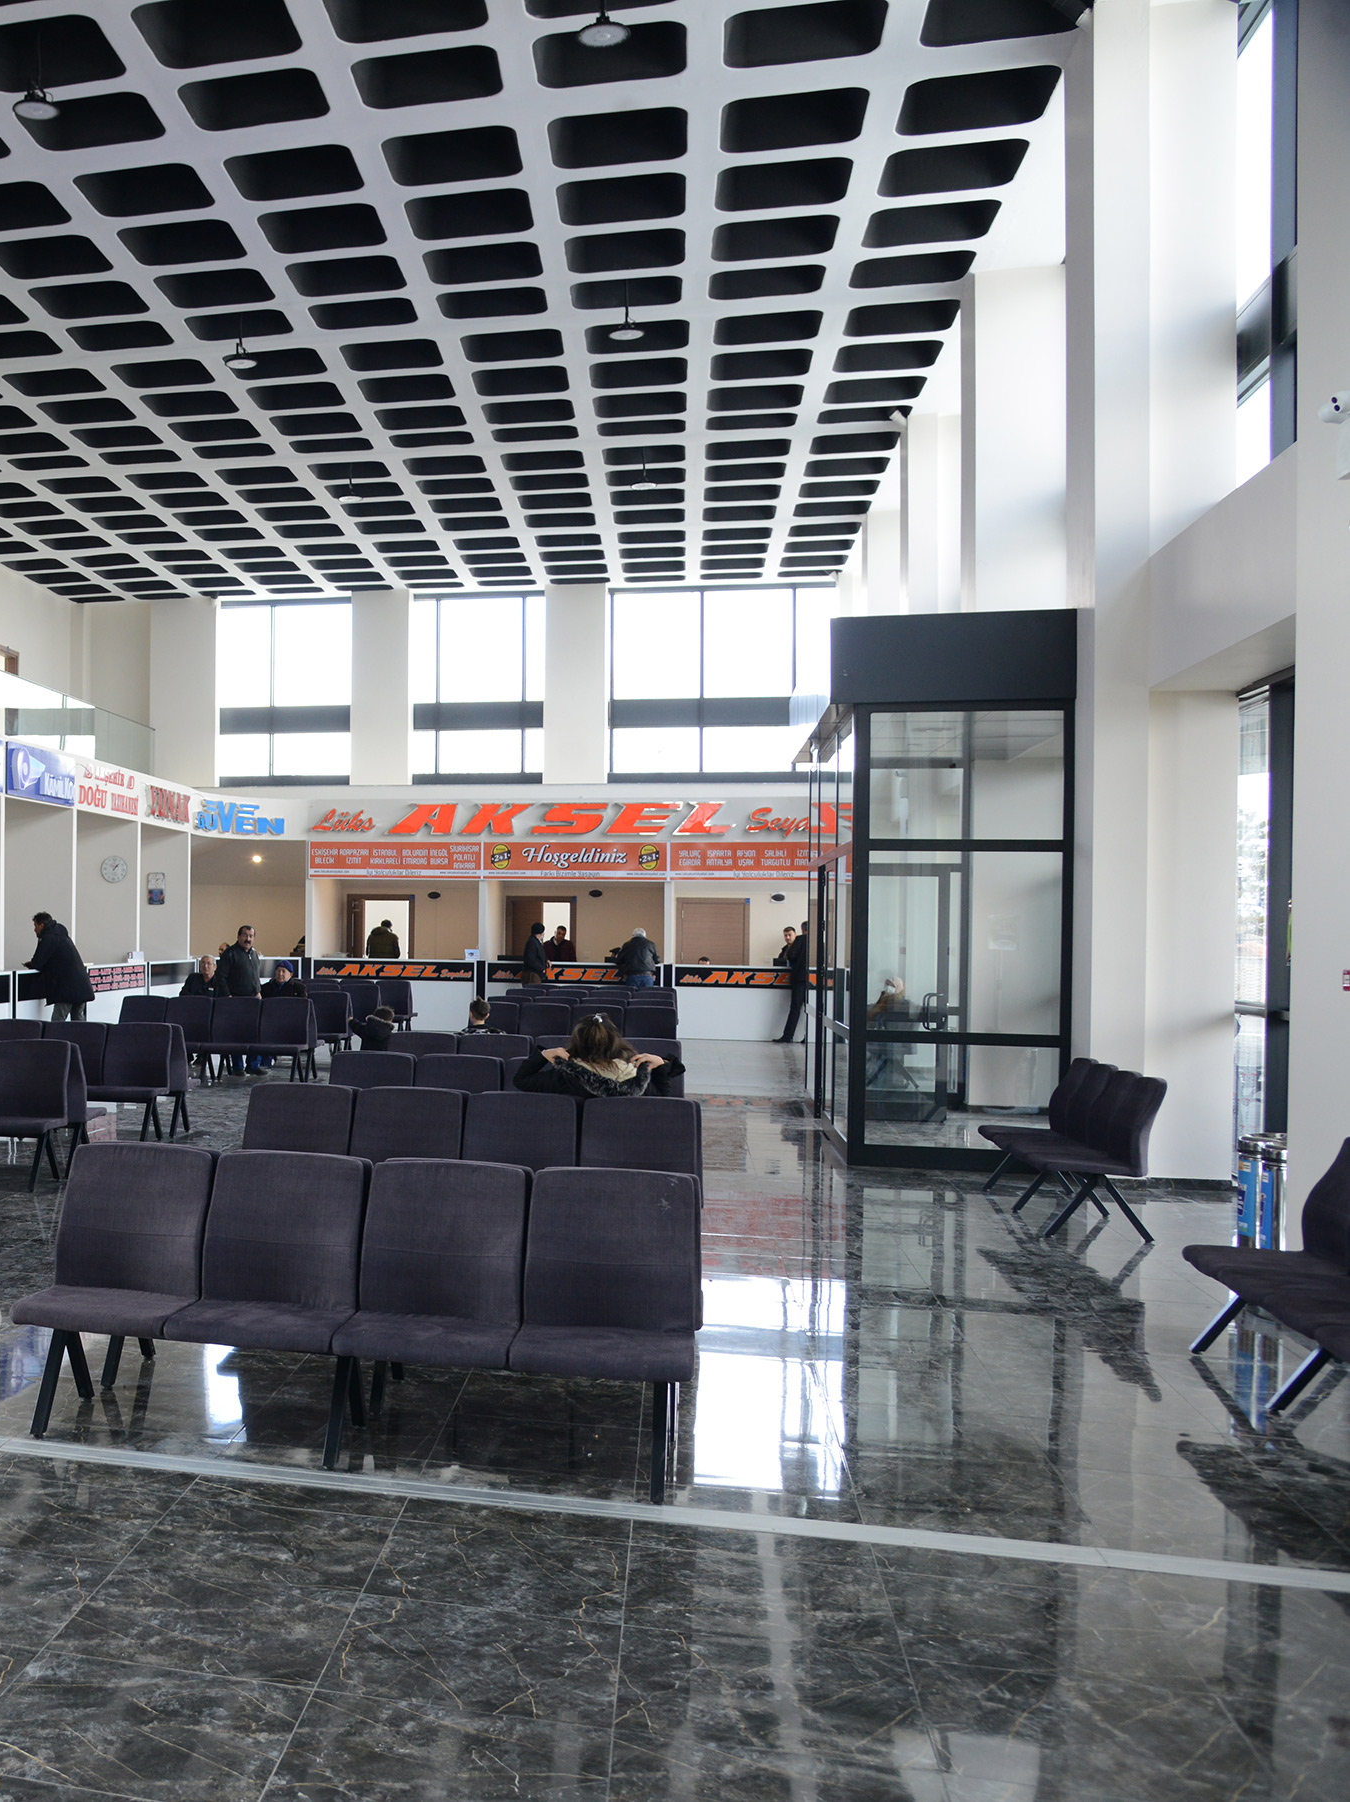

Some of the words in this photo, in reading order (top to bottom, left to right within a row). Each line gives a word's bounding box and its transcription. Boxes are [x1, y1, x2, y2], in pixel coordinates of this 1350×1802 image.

[78, 784, 108, 809] DOĞU
[312, 807, 376, 834] Lüks
[385, 800, 735, 837] AKSEL
[522, 844, 628, 869] Hoşgeldiniz
[338, 963, 440, 978] AKSEL
[703, 970, 792, 986] AKSE
